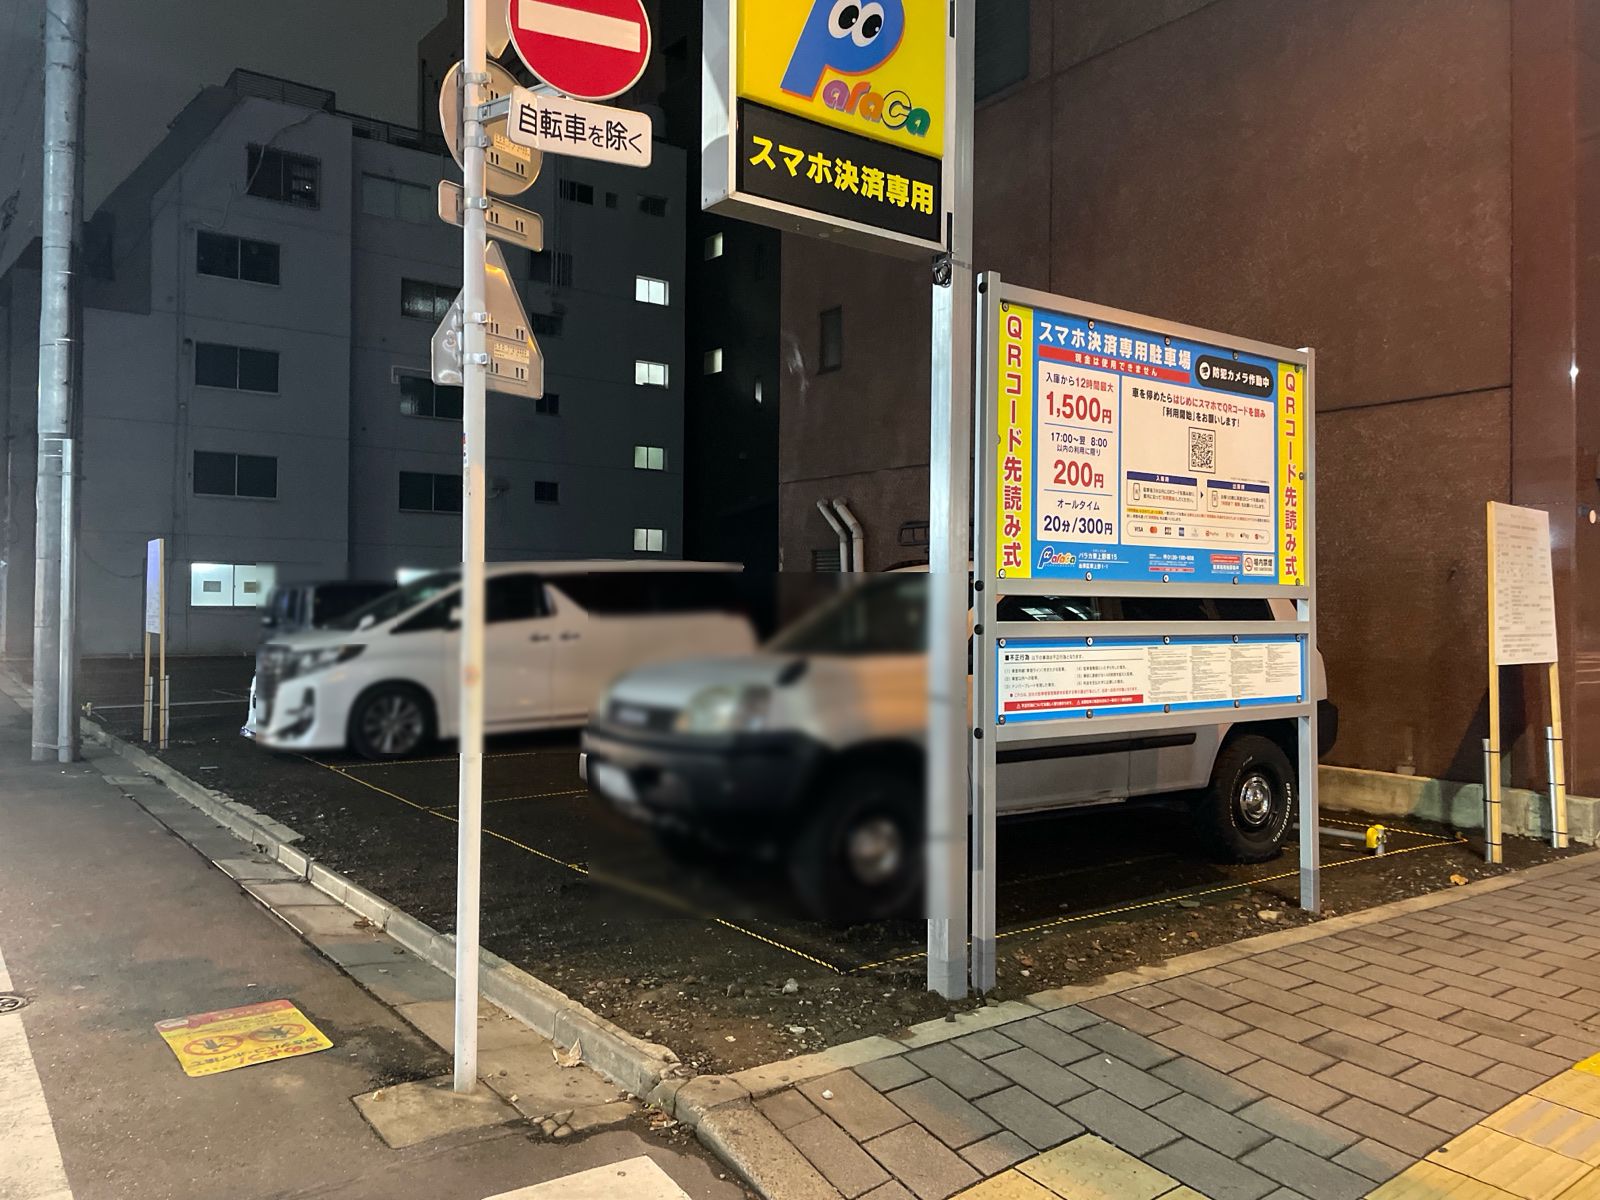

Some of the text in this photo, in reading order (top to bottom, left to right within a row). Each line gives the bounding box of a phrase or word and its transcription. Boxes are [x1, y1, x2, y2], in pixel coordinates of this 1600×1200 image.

[519, 103, 642, 154] 自転車を除く
[749, 135, 934, 215] スマホ決済専用
[1038, 321, 1192, 371] スマホ決済専用駐車場
[1074, 353, 1158, 377] 現金は使用できません
[1212, 366, 1270, 389] 防犯カメラ作動中
[1045, 371, 1114, 393] 入庫から12時間最大
[1046, 390, 1112, 424] 1,500円
[1003, 315, 1022, 568] QRコード先読み式
[1090, 436, 1108, 448] 8:00
[1053, 459, 1104, 488] 200円
[1284, 373, 1298, 577] QRコード先読み式
[1057, 498, 1101, 511] オールタイム
[1043, 515, 1113, 536] 20分/300円
